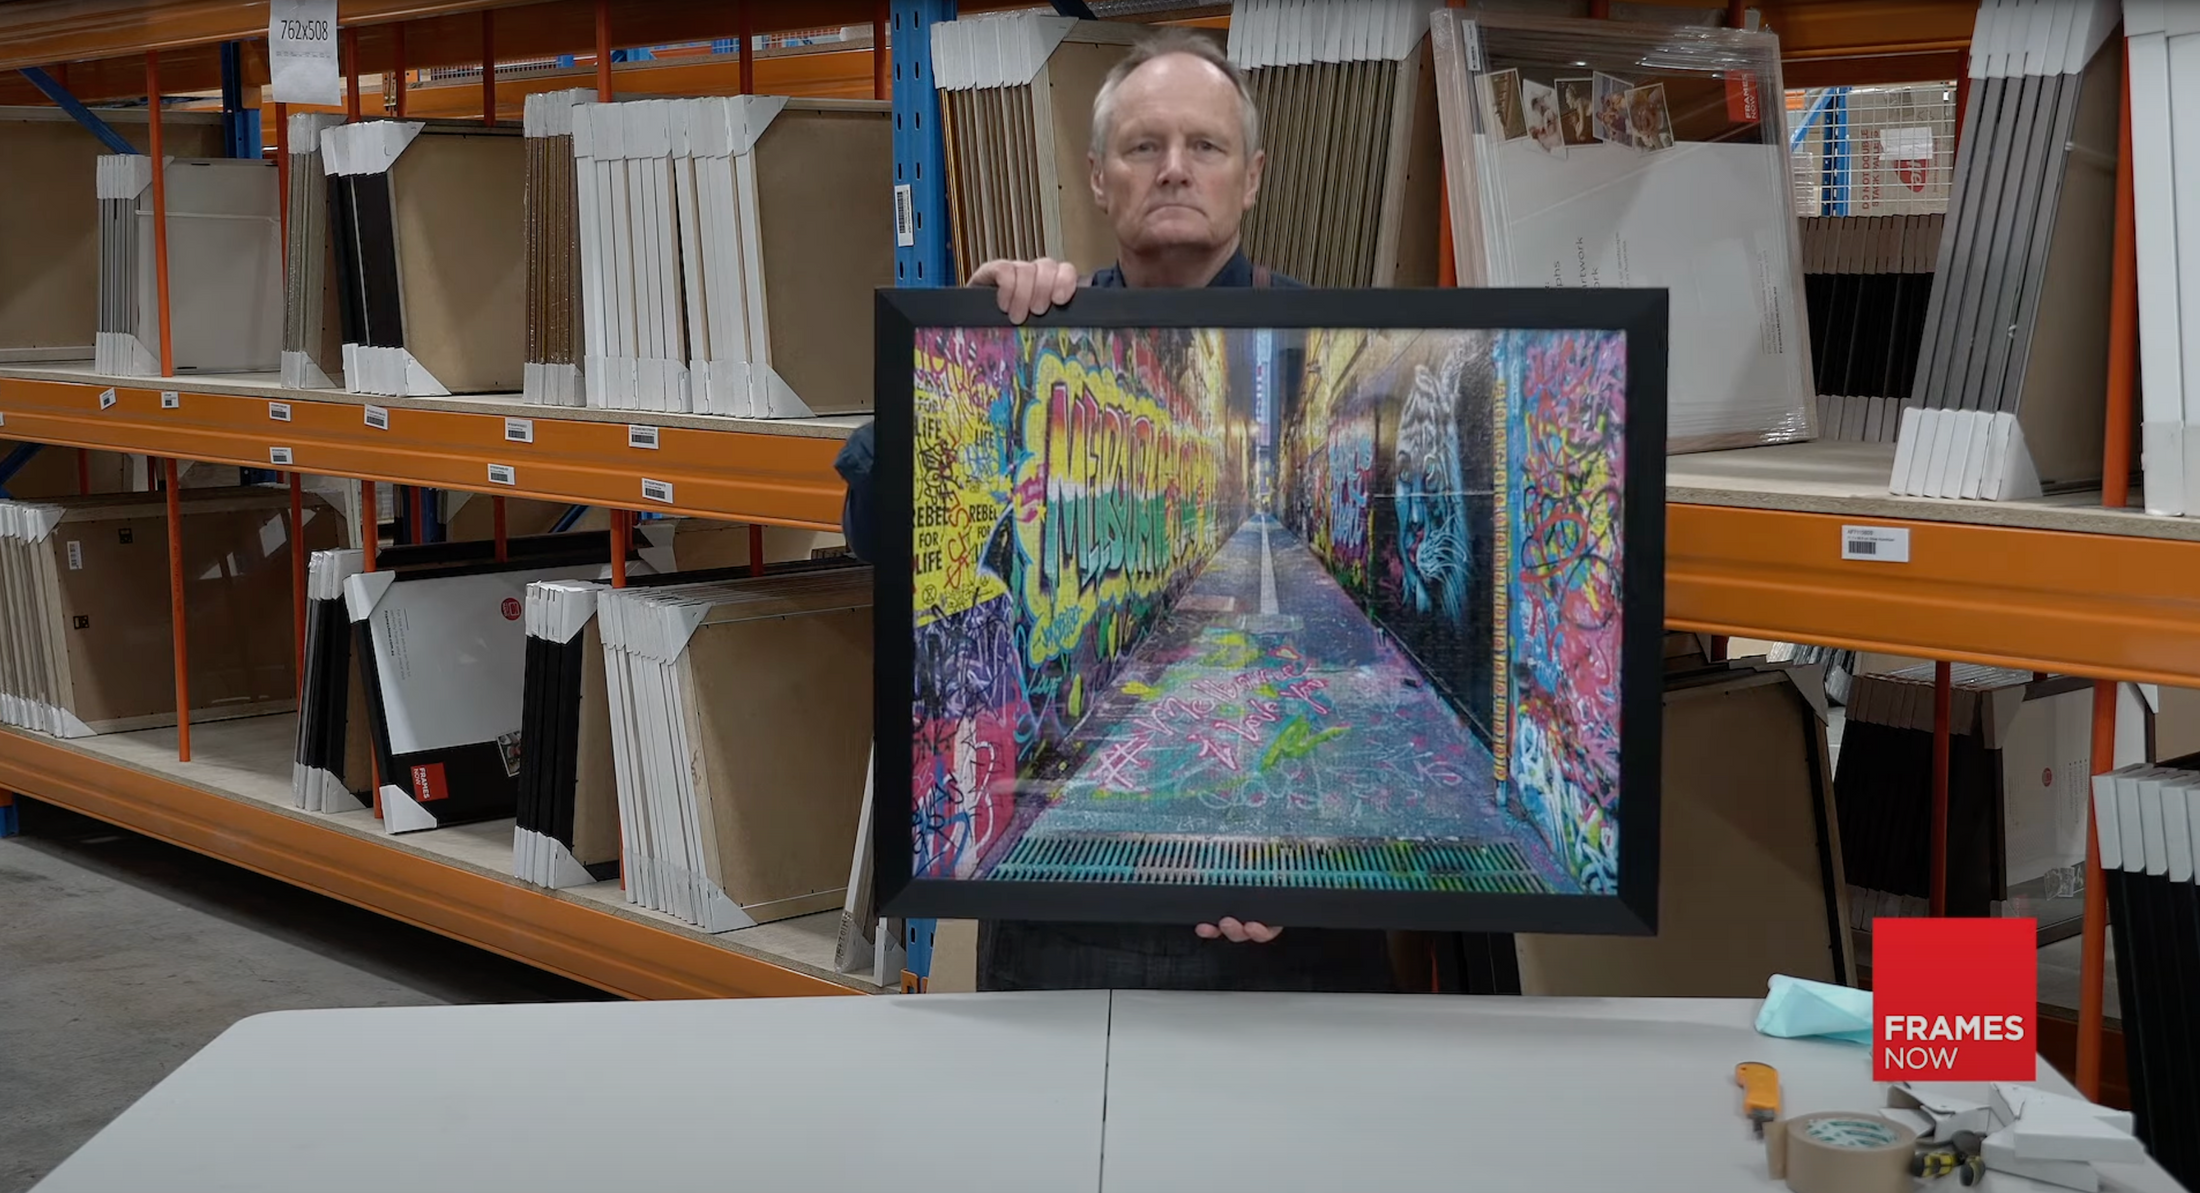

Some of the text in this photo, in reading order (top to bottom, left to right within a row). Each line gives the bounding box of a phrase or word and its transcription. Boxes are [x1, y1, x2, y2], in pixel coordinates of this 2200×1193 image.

[281, 20, 328, 40] 762x508
[1742, 74, 1752, 119] FRAMES
[1749, 95, 1757, 119] NOW
[1860, 128, 1869, 169] DOUBLE
[1862, 172, 1870, 192] NOT
[918, 531, 939, 549] FOR
[915, 550, 942, 575] LIFE
[420, 768, 430, 798] FRAMES
